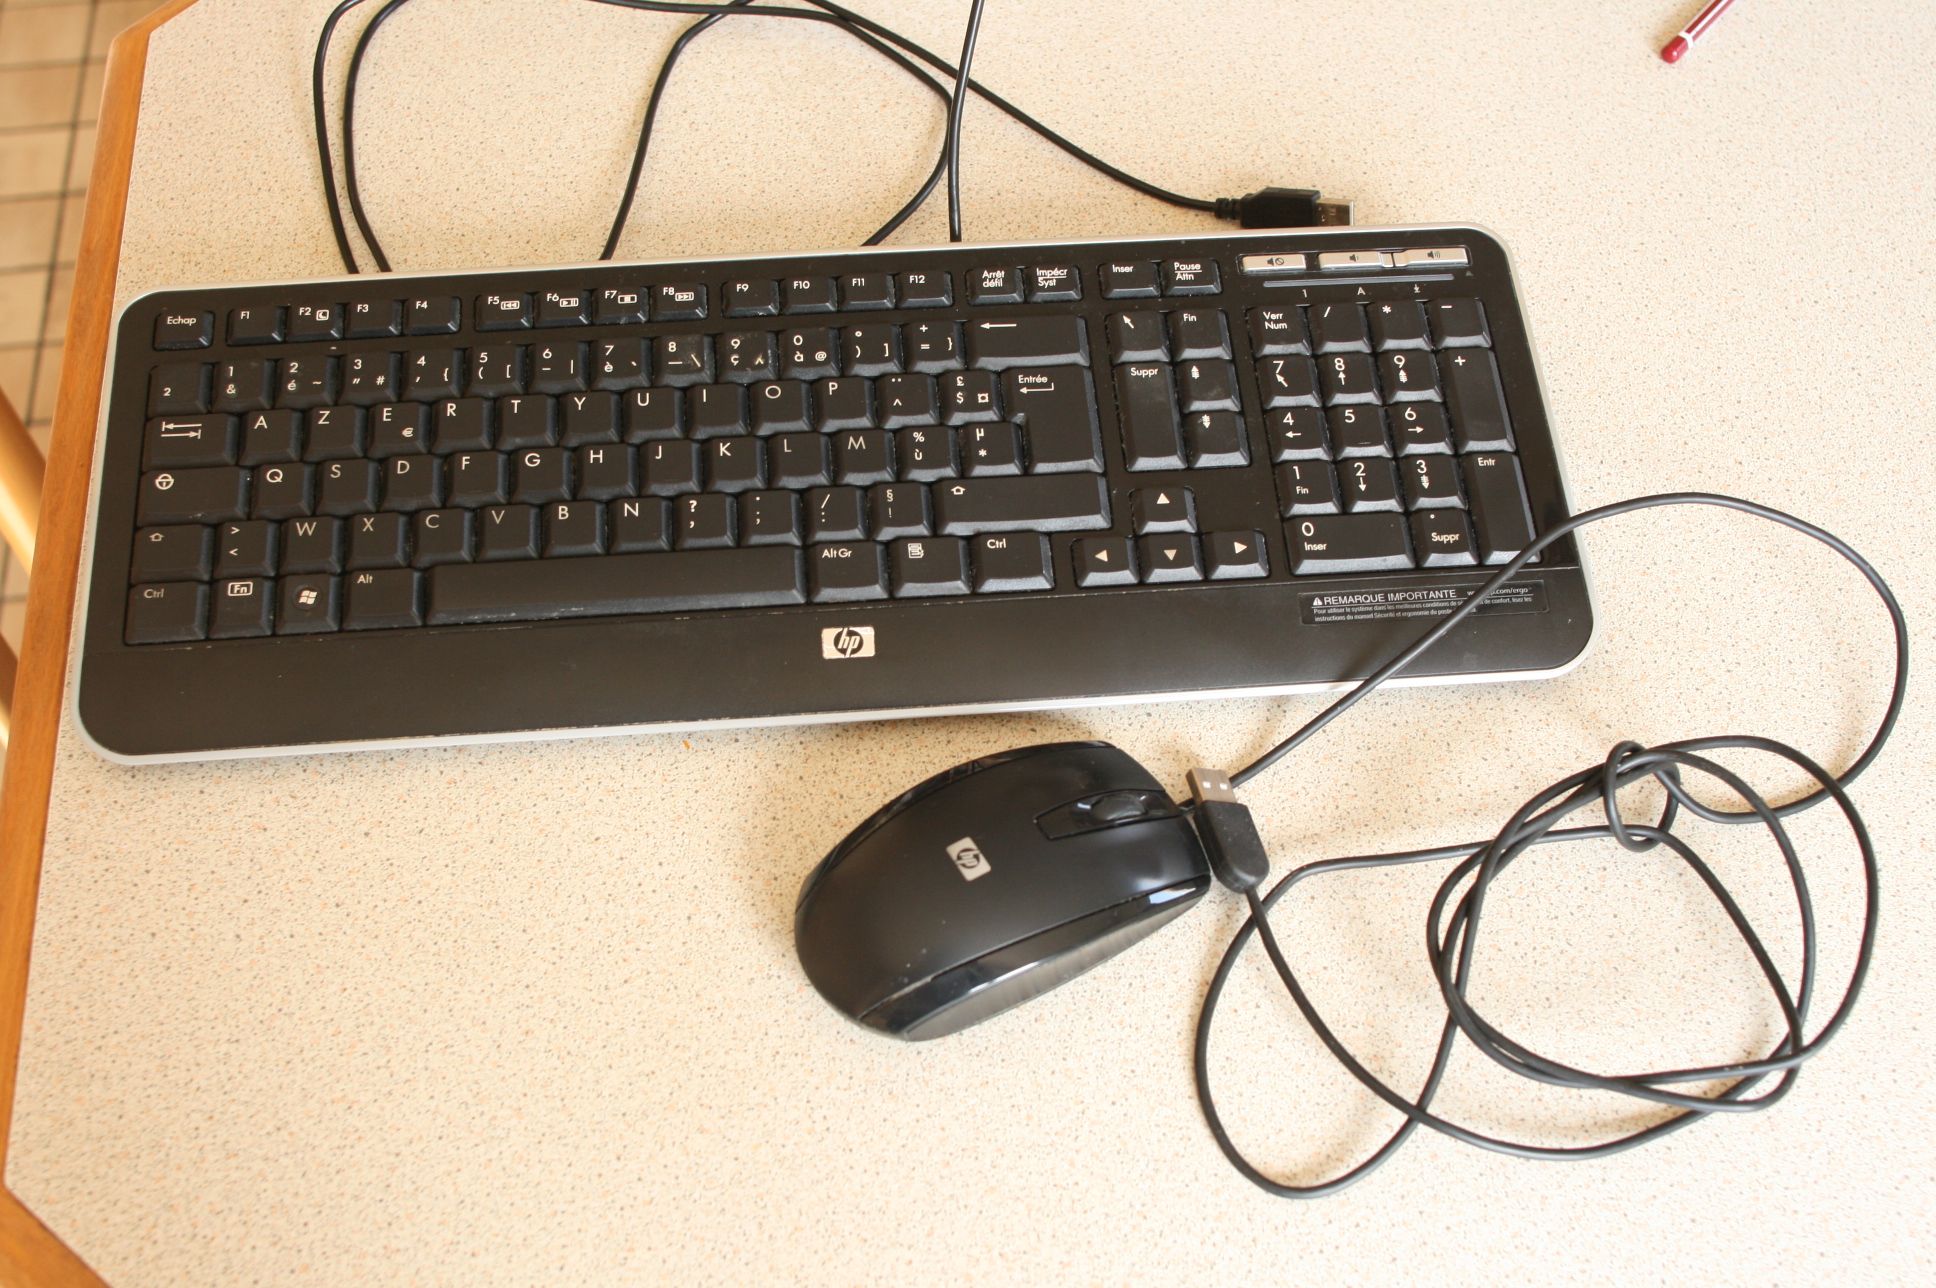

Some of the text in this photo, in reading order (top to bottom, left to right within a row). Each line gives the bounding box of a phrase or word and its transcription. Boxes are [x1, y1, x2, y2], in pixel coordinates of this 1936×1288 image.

[1112, 264, 1133, 272] Inser
[1174, 261, 1201, 271] Pause
[982, 269, 1005, 279] Arrêt
[1036, 267, 1067, 278] Impécr
[1175, 272, 1194, 281] Attn
[852, 278, 864, 286] F11
[910, 275, 925, 283] F12
[982, 279, 1003, 288] défil
[1038, 277, 1057, 287] Syst
[737, 284, 749, 292] F9
[794, 281, 810, 289] F10
[604, 289, 617, 299] F7
[662, 286, 675, 296] F8
[1357, 287, 1365, 295] A
[487, 295, 500, 305] F5
[546, 292, 559, 302] F6
[357, 304, 368, 312] F3
[416, 301, 427, 309] F4
[241, 311, 249, 319] F1
[298, 306, 312, 316] F2
[1263, 311, 1283, 320] Verr
[167, 316, 196, 326] Echap
[1183, 313, 1196, 321] Fin
[1264, 321, 1287, 330] Num
[668, 341, 676, 352] 8
[731, 336, 741, 349] 9
[543, 348, 552, 359] 6
[605, 345, 614, 356] 7
[417, 356, 426, 366] 4
[479, 352, 488, 363] 5
[794, 351, 827, 362] à @
[1393, 354, 1405, 368] 9
[289, 362, 298, 373] 2
[354, 359, 362, 369] 3
[604, 361, 613, 372] è
[1272, 359, 1284, 374] 7
[1334, 357, 1345, 371] 8
[229, 366, 233, 376] 1
[1131, 367, 1158, 378] Suppr
[376, 376, 385, 385] #
[957, 376, 964, 386] £
[1018, 374, 1048, 384] Entrée
[226, 384, 236, 394] &
[288, 380, 296, 390] é
[829, 382, 838, 395] P
[574, 397, 586, 410] Y
[638, 393, 649, 406] U
[957, 392, 964, 404] $
[447, 403, 456, 416] R
[511, 400, 521, 413] T
[318, 411, 330, 424] Z
[383, 408, 392, 421] E
[1283, 412, 1294, 425] 4
[1345, 409, 1355, 423] 5
[1405, 407, 1416, 420] 6
[254, 416, 267, 429] A
[402, 428, 413, 437] €
[913, 432, 925, 442] %
[784, 439, 791, 452] L
[848, 436, 865, 449] M
[655, 445, 662, 459] J
[720, 442, 731, 456] K
[915, 449, 922, 460] ù
[525, 453, 540, 467] G
[590, 450, 603, 463] H
[1478, 457, 1495, 466] Entr
[397, 461, 409, 474] D
[462, 456, 470, 470] F
[1353, 461, 1366, 476] 2
[1415, 459, 1427, 474] 3
[266, 469, 283, 483] Q
[331, 464, 341, 478] S
[1293, 466, 1300, 479] 1
[1296, 486, 1309, 494] Fin
[624, 503, 638, 517] N
[689, 500, 697, 512] ?
[492, 510, 504, 524] V
[558, 506, 569, 520] B
[363, 518, 374, 531] X
[426, 514, 439, 528] C
[296, 522, 316, 536] W
[987, 538, 1006, 549] Ctrl
[1431, 532, 1459, 544] Suppr
[1304, 542, 1327, 551] Inser
[357, 574, 373, 583] Alt
[144, 589, 164, 598] Ctrl
[234, 584, 248, 593] Fn
[1324, 593, 1385, 605] REMARQUE
[1388, 589, 1457, 602] IMPORTANTE
